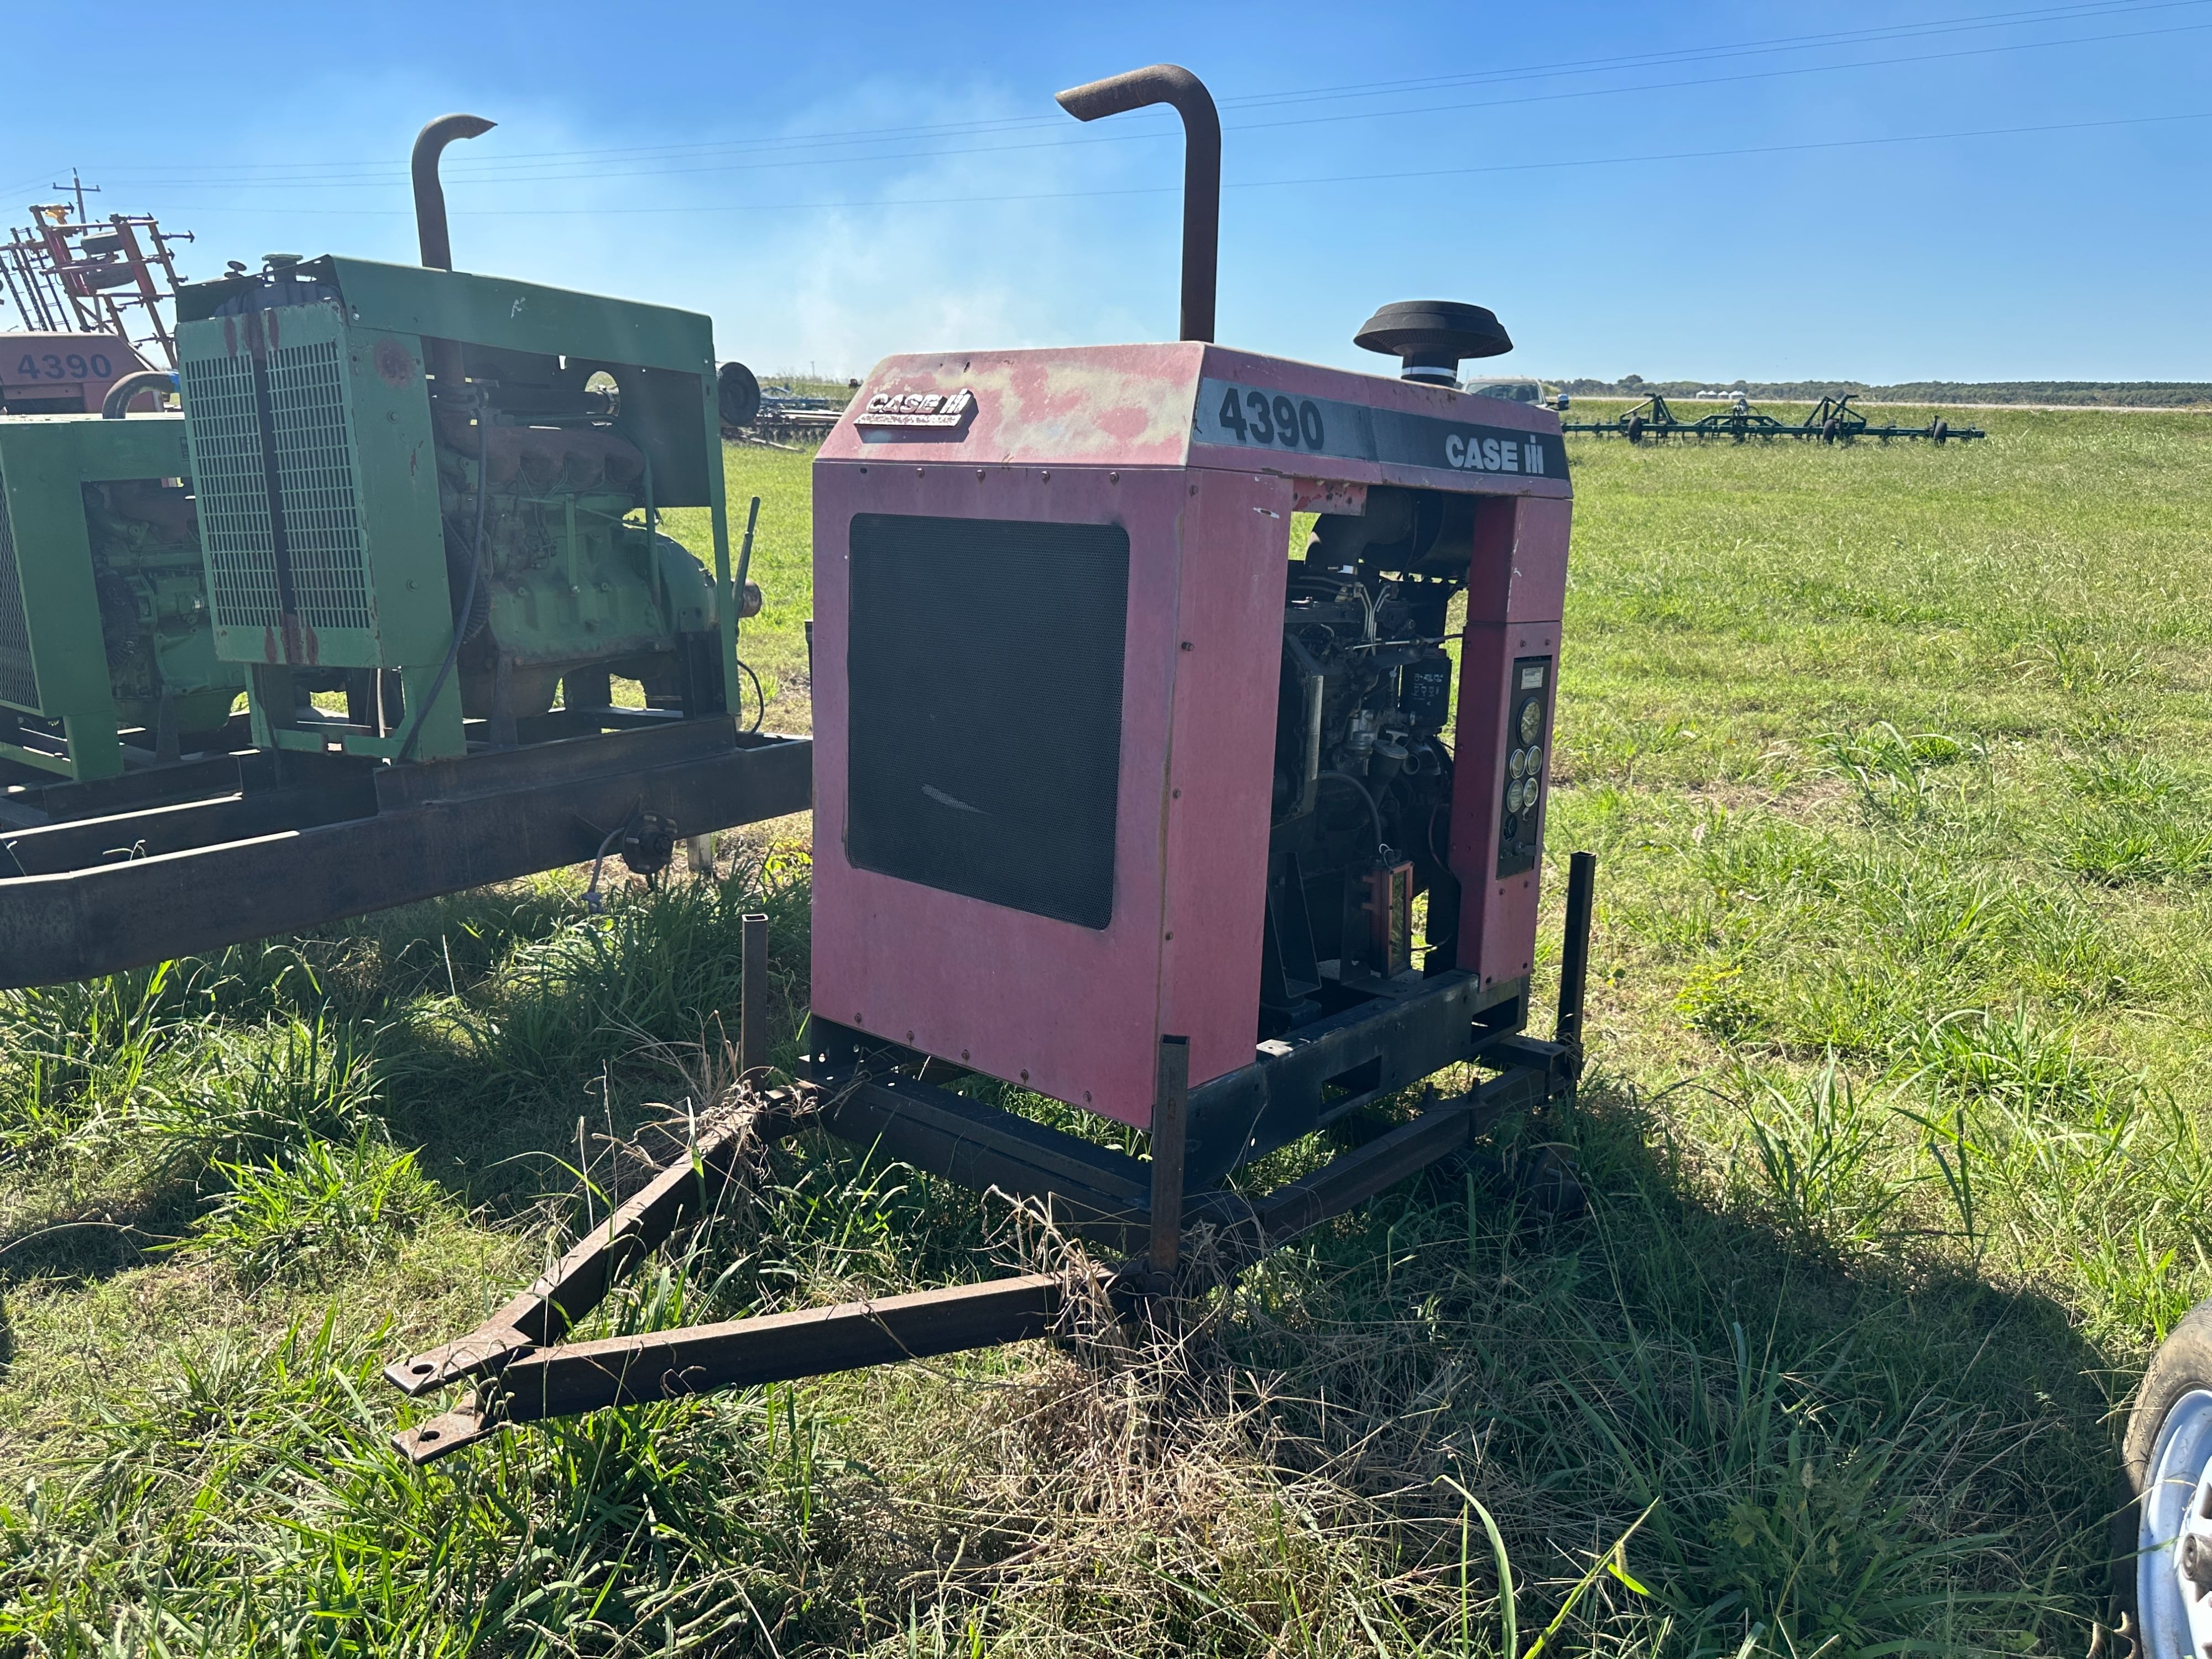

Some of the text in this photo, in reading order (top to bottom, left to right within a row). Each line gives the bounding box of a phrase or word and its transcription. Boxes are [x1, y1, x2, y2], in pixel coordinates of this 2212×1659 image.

[18, 354, 112, 379] 4390
[866, 393, 940, 413] CASE
[1219, 388, 1324, 450] 4390
[1446, 434, 1518, 471] CASE
